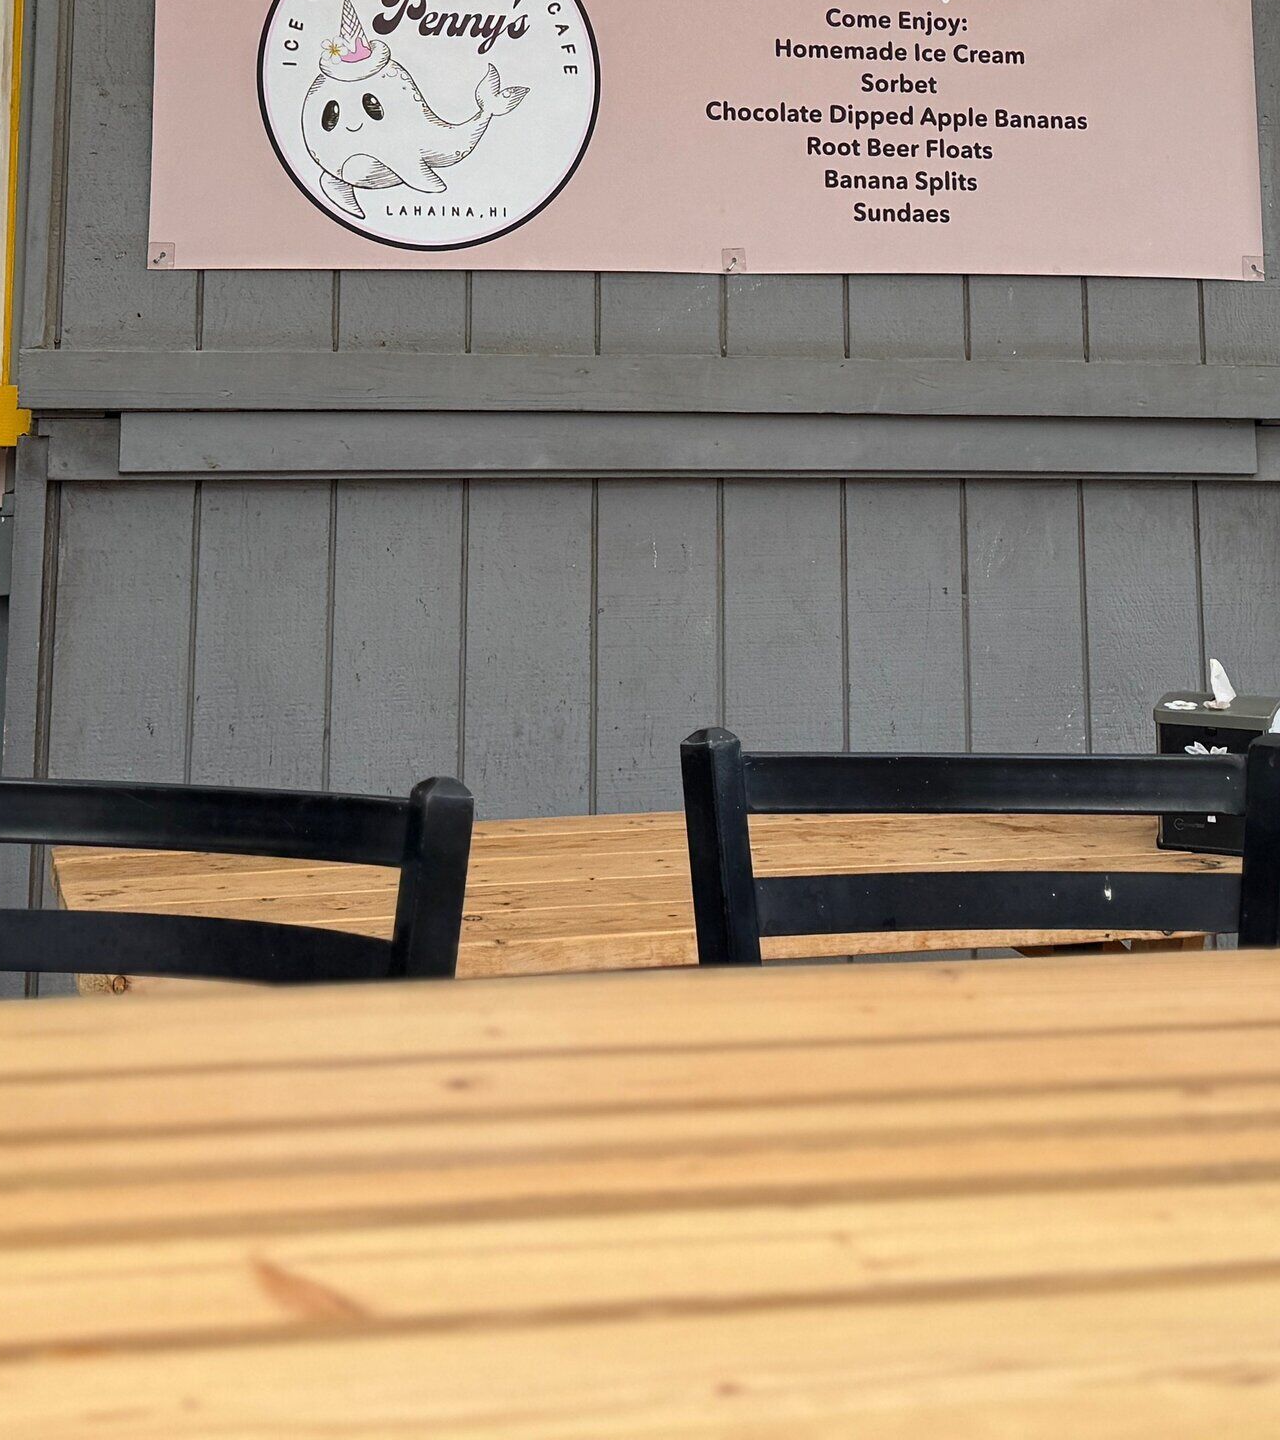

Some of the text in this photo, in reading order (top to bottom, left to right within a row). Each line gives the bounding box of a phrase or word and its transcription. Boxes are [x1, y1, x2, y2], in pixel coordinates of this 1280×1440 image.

[825, 8, 968, 36] Come Enjoy:
[282, 18, 303, 66] ICE
[547, 1, 577, 75] CAFE
[775, 39, 1025, 65] Homemade Ice Cream
[861, 73, 937, 94] Sorbet
[705, 101, 1088, 131] Chocolate Dipped Apple Bananas
[807, 136, 993, 160] Root Beer Floats
[824, 170, 978, 196] Banana Splits
[853, 202, 951, 223] Sundaes
